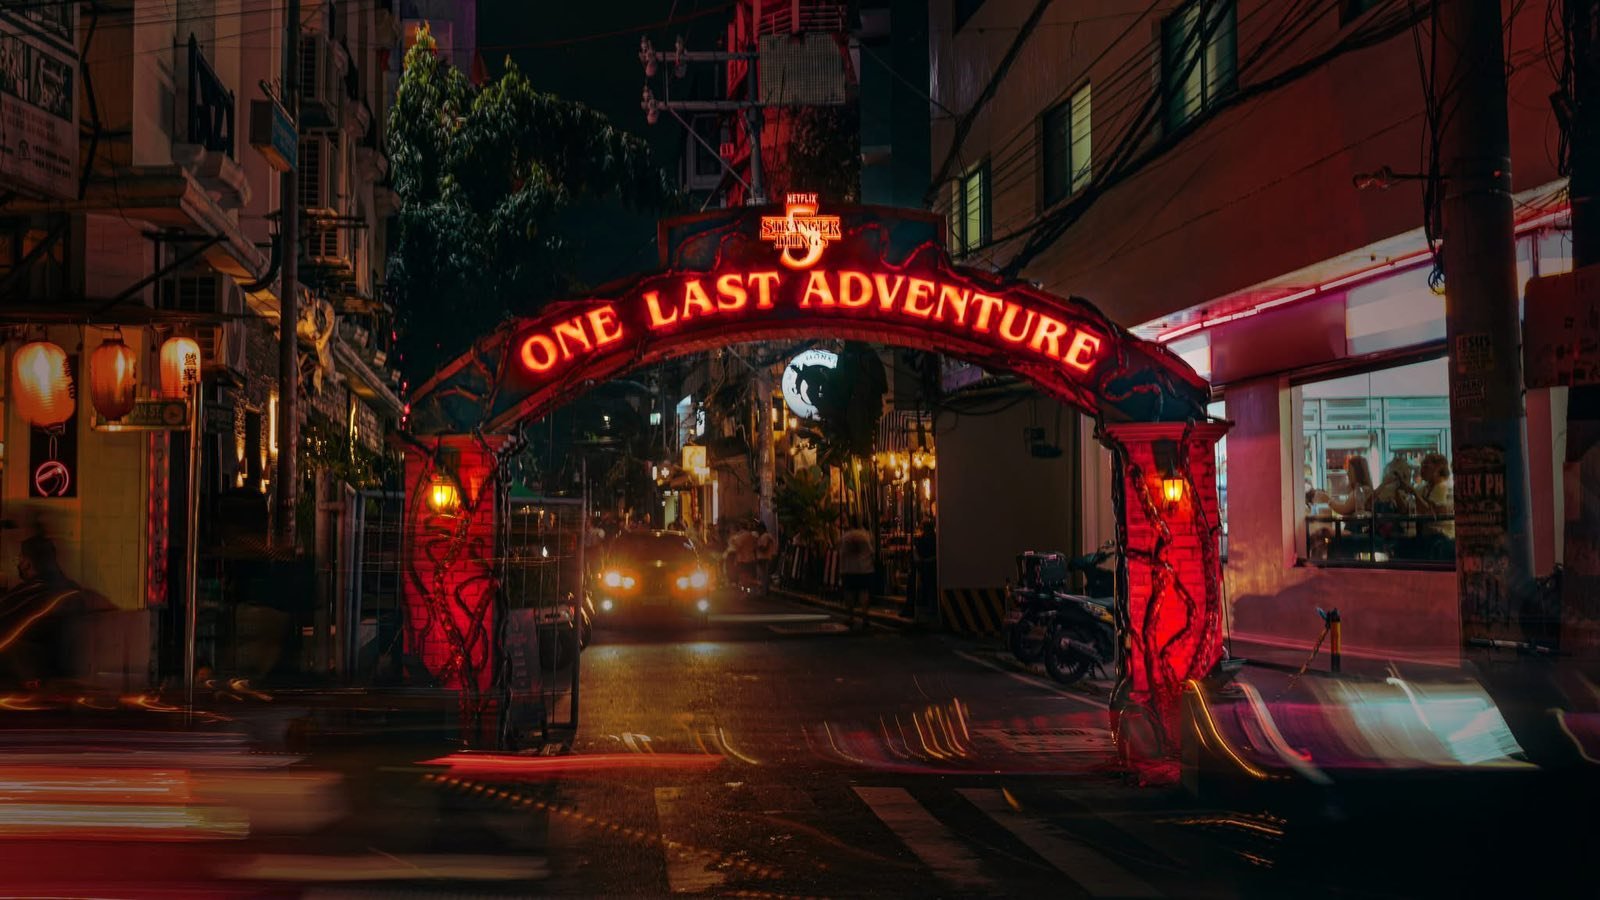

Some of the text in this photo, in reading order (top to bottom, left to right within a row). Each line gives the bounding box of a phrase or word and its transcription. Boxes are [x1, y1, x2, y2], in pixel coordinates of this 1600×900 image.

[787, 193, 817, 205] NETFLIX
[761, 217, 841, 238] STRANGER
[774, 233, 829, 249] THINGS
[522, 271, 1100, 371] ONE LAST ADVENTURE
